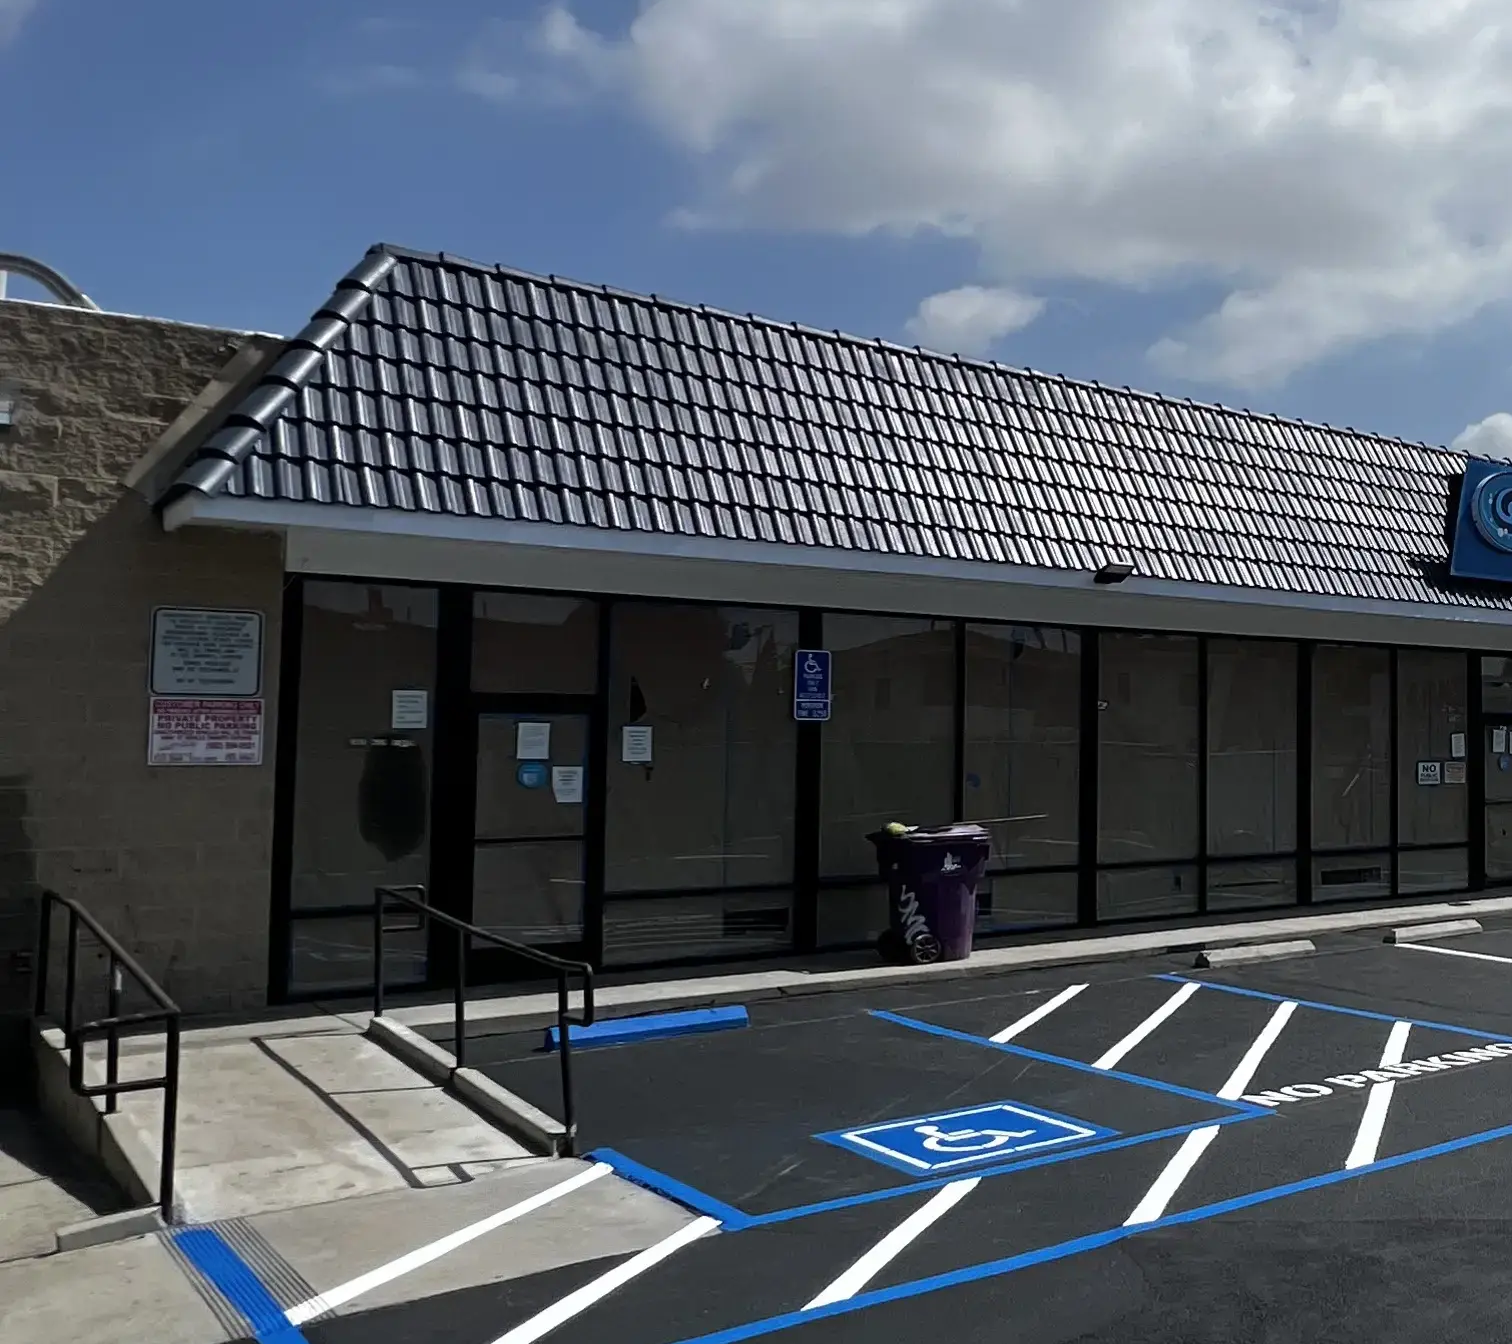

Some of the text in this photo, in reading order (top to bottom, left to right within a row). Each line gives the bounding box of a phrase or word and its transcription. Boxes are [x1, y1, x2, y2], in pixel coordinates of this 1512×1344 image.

[204, 715, 257, 723] PROPERTY
[1422, 764, 1436, 773] NO
[1241, 1083, 1333, 1107] NO
